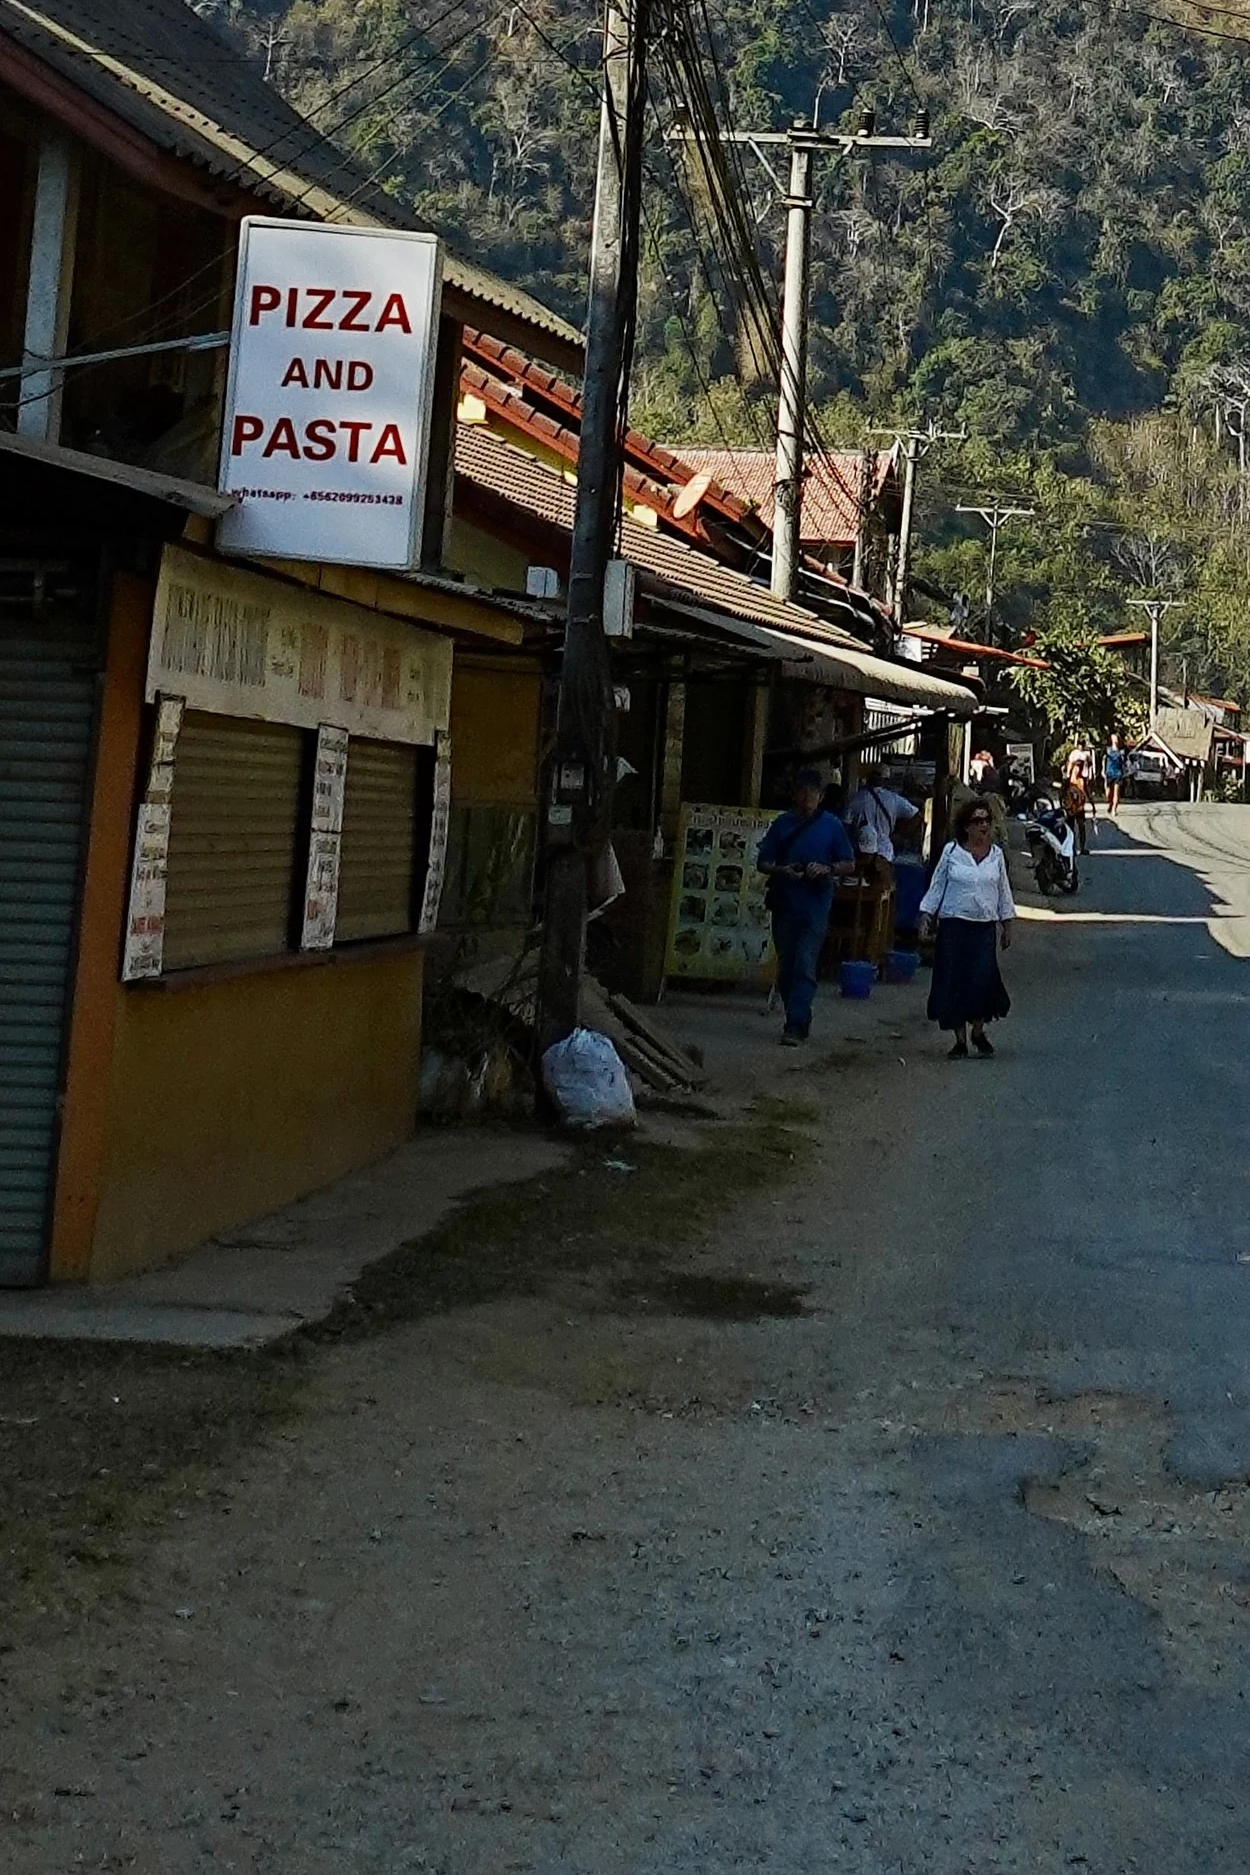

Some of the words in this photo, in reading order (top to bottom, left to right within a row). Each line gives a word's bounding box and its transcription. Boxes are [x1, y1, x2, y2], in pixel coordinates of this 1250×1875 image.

[249, 285, 412, 334] PIZZA
[281, 357, 373, 391] AND
[231, 415, 407, 465] PASTA
